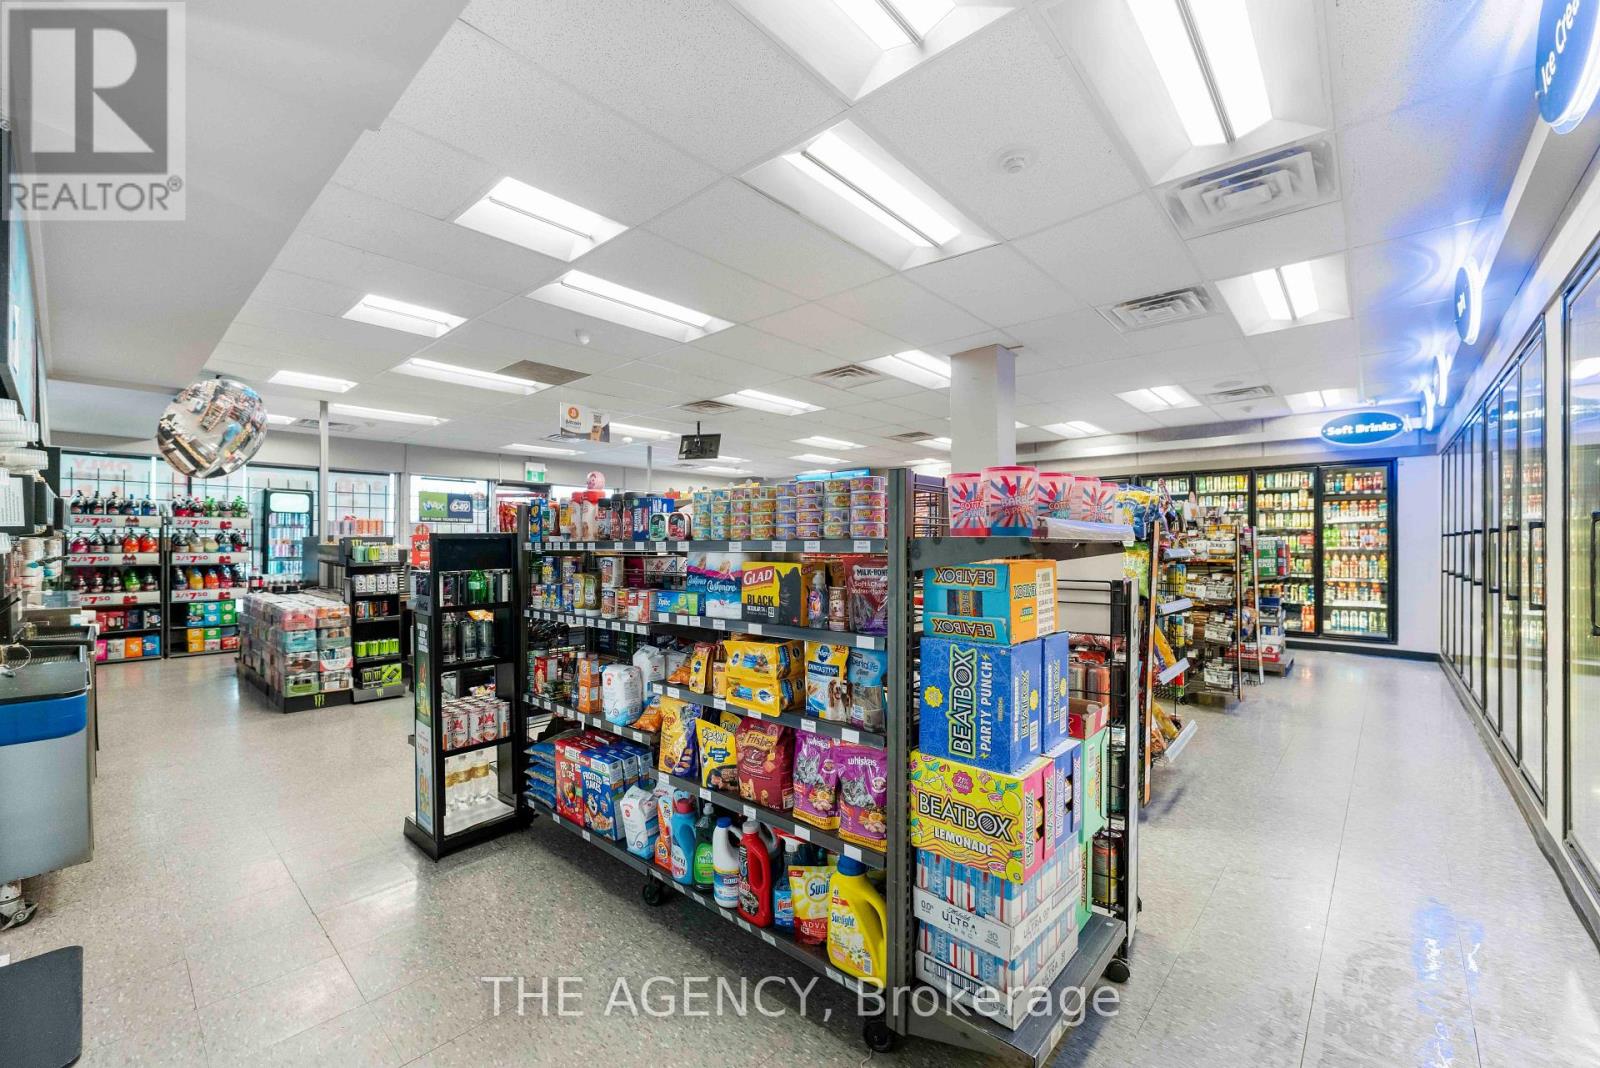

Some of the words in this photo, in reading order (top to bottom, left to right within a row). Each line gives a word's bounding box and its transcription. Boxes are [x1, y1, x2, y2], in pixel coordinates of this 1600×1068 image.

[1541, 51, 1556, 94] Ice
[1327, 424, 1353, 436] Soft
[1355, 422, 1397, 434] Drinks
[743, 569, 773, 585] GLAD
[936, 568, 995, 585] BEATBOX
[707, 580, 737, 592] Cashmere
[747, 594, 774, 607] BLACK
[935, 620, 994, 637] BEATBOX
[981, 661, 993, 706] PUNCH
[953, 652, 974, 754] BEATBOX
[980, 713, 993, 752] PARTY
[848, 756, 877, 767] whiskas
[919, 792, 1013, 843] BEATBOX
[933, 826, 993, 857] LEMONADE
[832, 912, 855, 928] Sunlight
[942, 910, 977, 935] ULTRA
